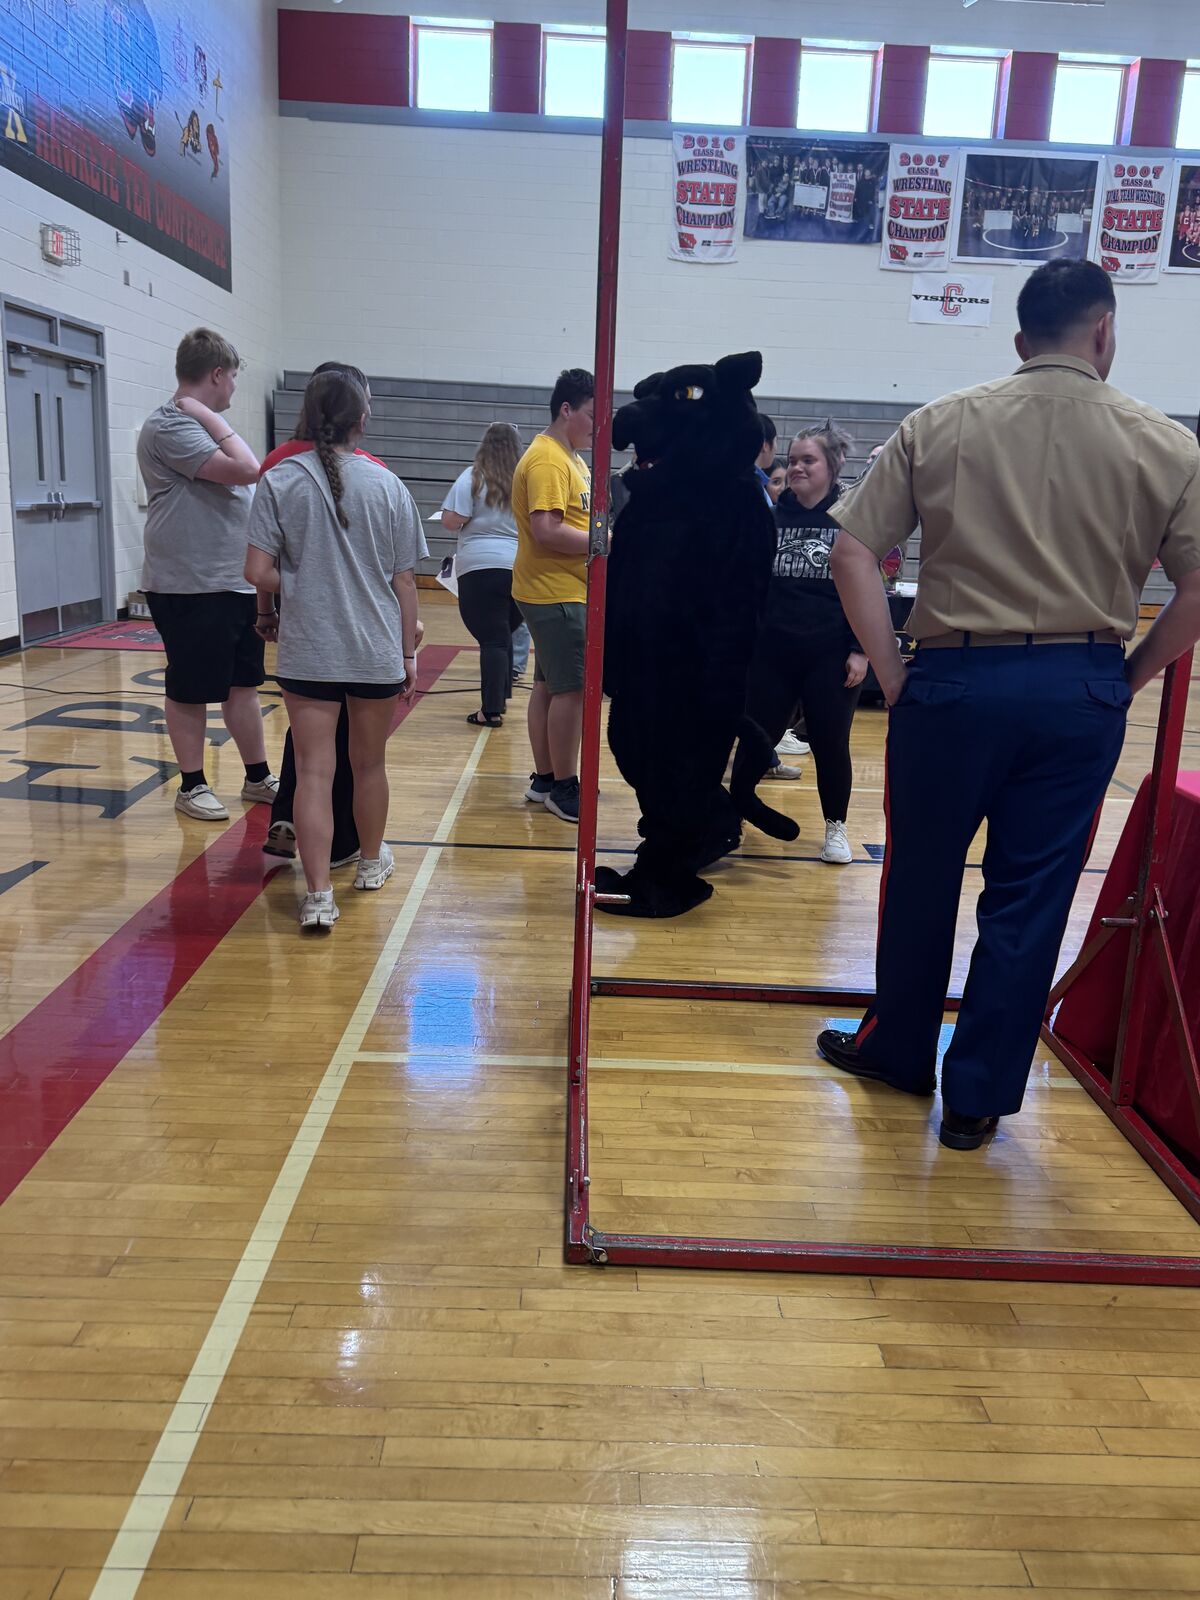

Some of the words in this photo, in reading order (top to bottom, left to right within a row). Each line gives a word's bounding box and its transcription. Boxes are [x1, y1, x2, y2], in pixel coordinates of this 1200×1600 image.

[683, 135, 735, 151] 2016
[693, 149, 714, 158] CLASS
[899, 152, 950, 168] 2007
[677, 158, 738, 180] WRESTLING
[907, 167, 929, 176] CLASS
[1114, 164, 1164, 179] 2007
[893, 177, 952, 196] WRESTLING
[1121, 178, 1142, 187] CLASS
[676, 180, 737, 206] STATE
[1120, 188, 1134, 203] TEAM
[1135, 190, 1165, 207] WRESTLING
[889, 195, 951, 220] STATE
[676, 206, 735, 229] CHAMPION
[1102, 206, 1164, 232] STATE
[888, 219, 949, 242] CHAMPION
[1101, 230, 1161, 253] CHAMPION
[912, 294, 990, 304] VISITORS
